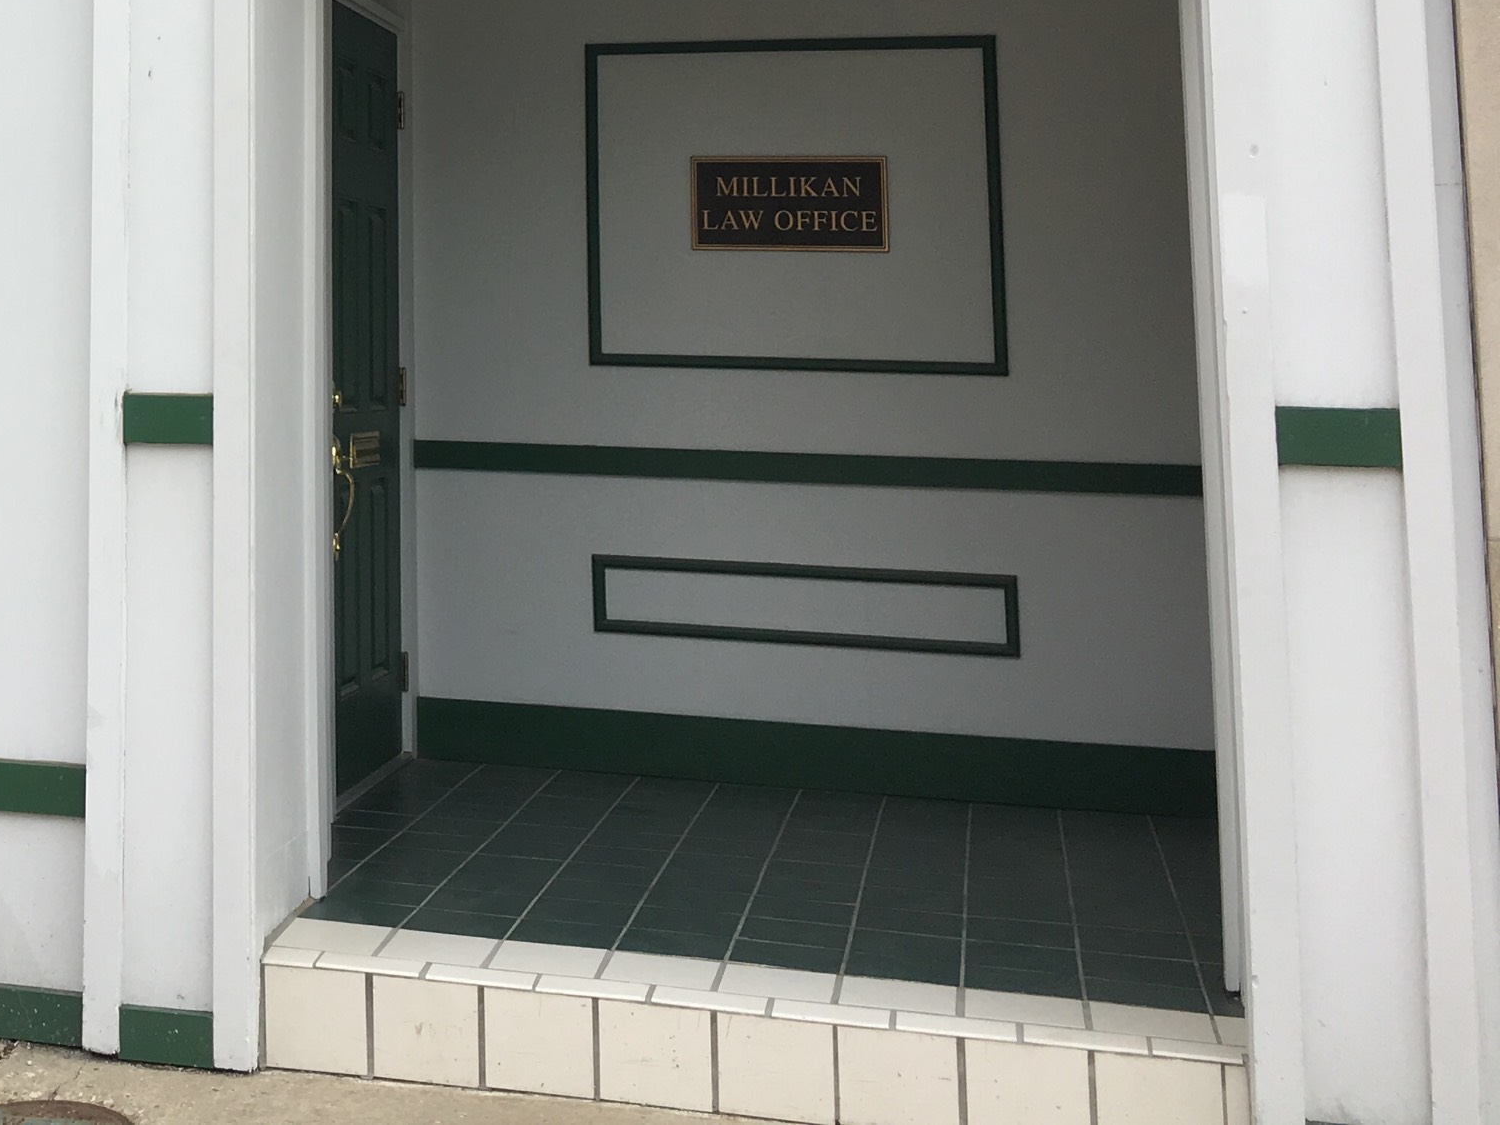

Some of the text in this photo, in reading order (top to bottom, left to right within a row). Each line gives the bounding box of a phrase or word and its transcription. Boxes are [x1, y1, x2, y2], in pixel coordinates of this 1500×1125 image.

[715, 176, 862, 198] MILLIKAN
[701, 209, 879, 233] LAW OFFICE
